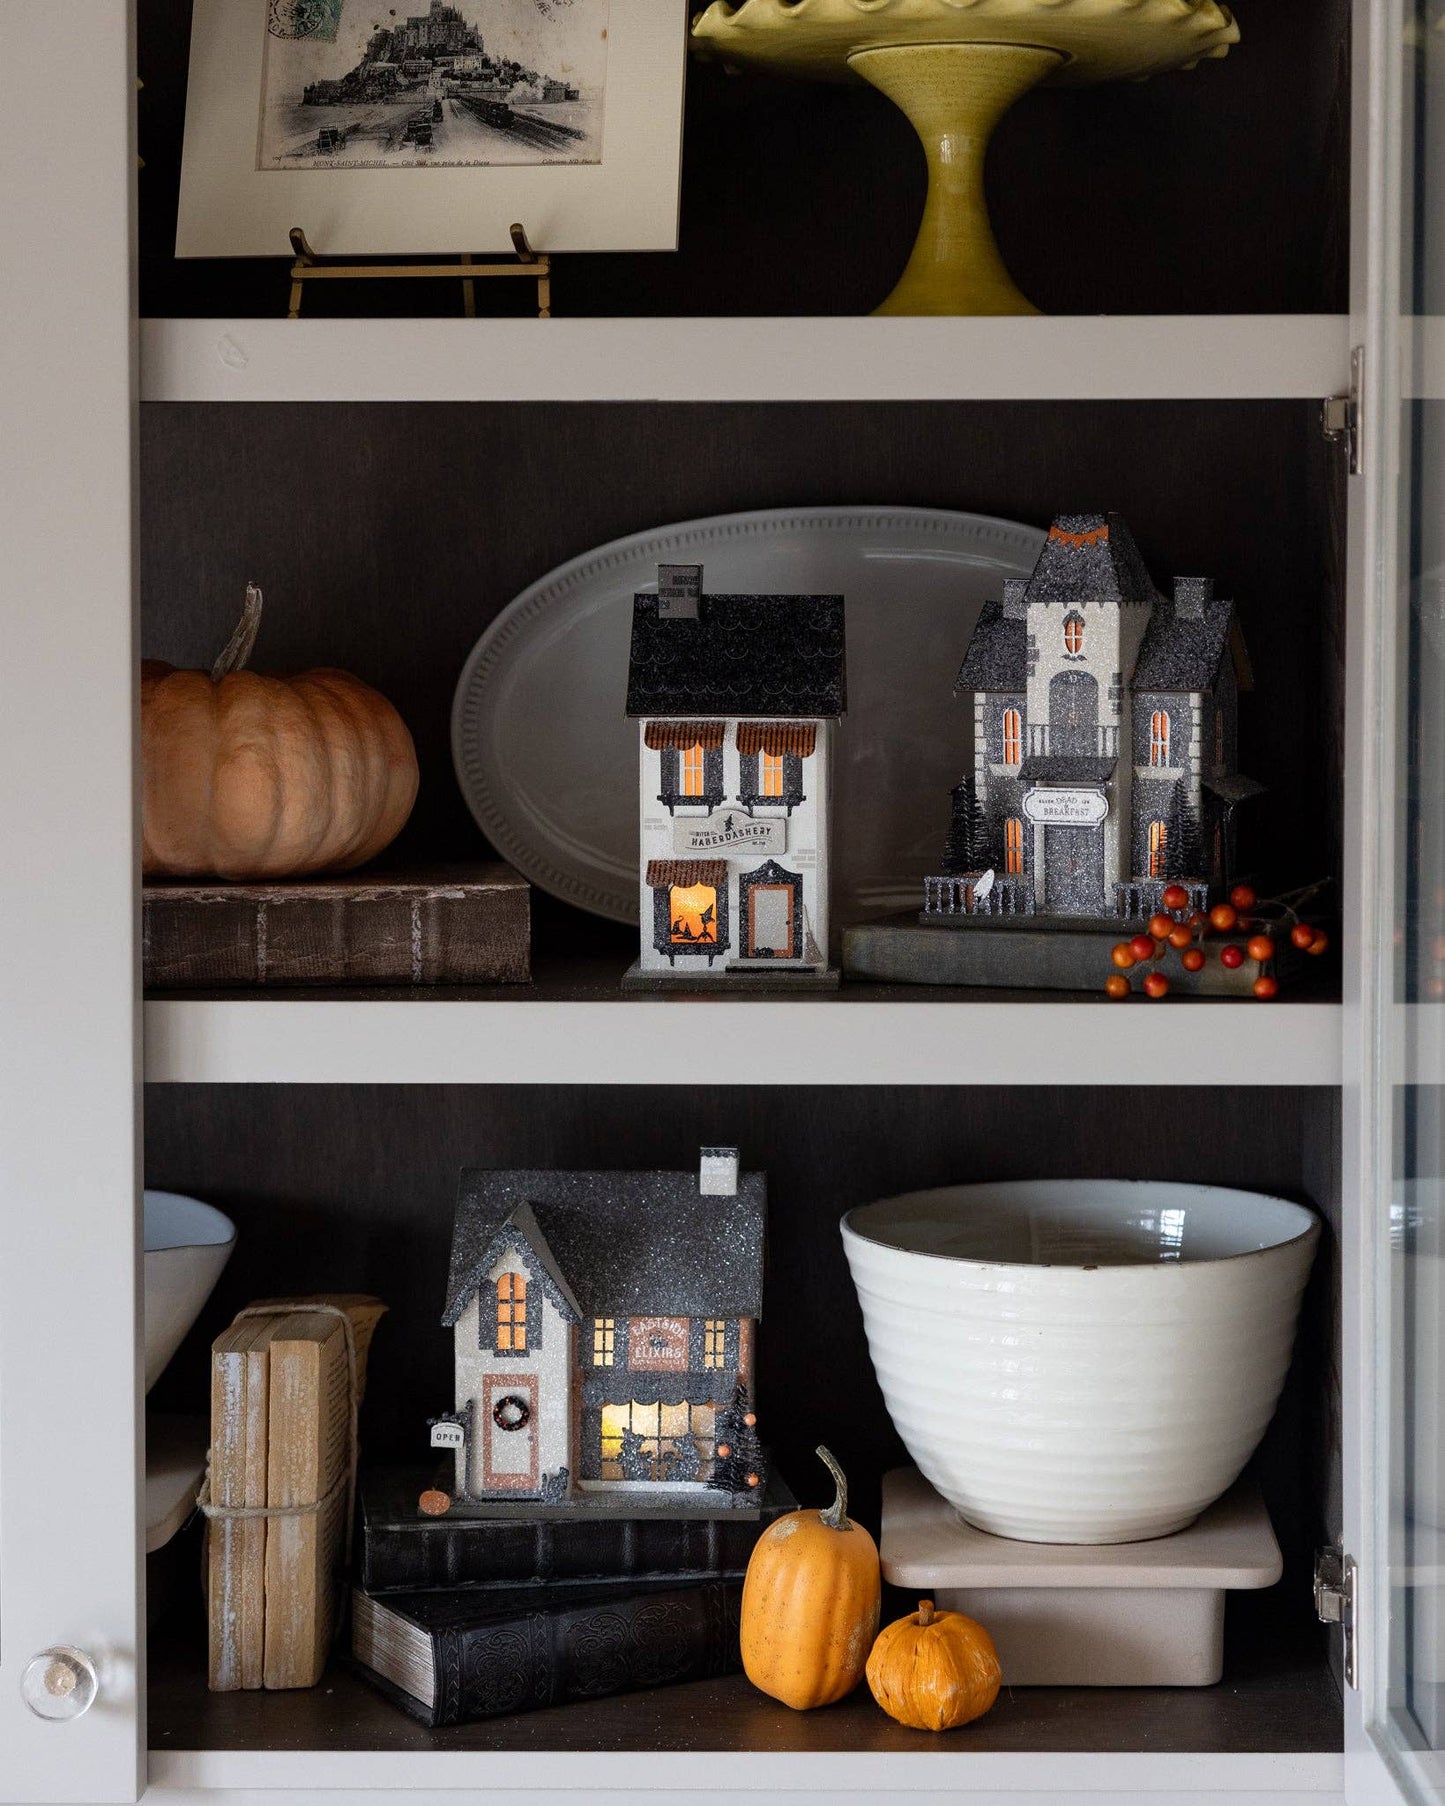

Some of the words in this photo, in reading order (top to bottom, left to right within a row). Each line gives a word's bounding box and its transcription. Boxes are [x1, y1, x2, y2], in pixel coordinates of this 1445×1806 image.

[1044, 807, 1090, 816] BREAKFAST
[691, 826, 772, 847] HABERDASHERY
[631, 1316, 687, 1338] EASTSIDE
[635, 1346, 682, 1358] ELIXIRS
[436, 1433, 460, 1442] OPEN
